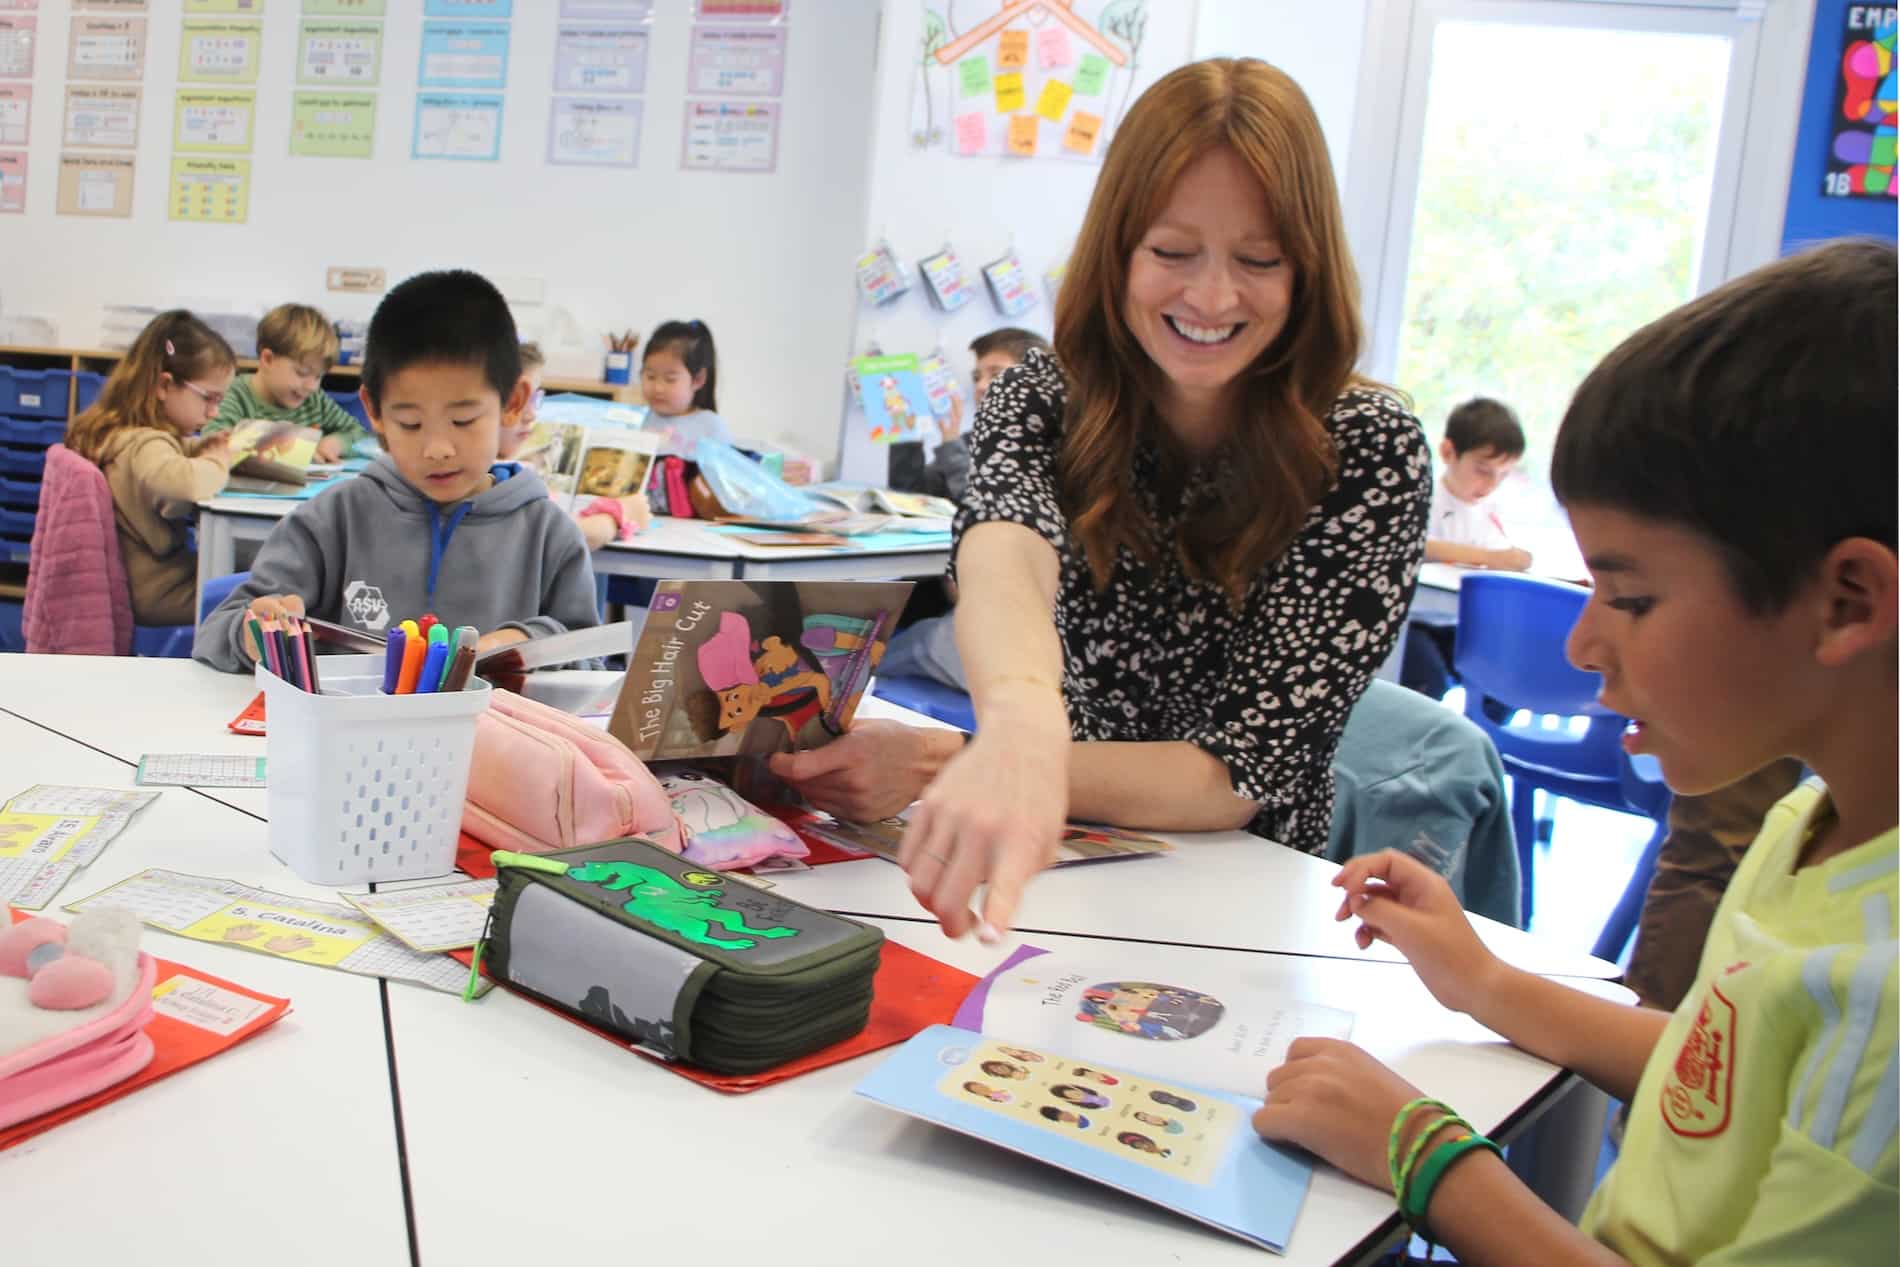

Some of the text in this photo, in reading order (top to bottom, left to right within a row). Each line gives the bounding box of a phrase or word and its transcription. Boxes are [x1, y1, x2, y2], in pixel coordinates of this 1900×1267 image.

[1848, 6, 1897, 30] EMP
[639, 599, 712, 743] The Big Hair Cut
[257, 911, 348, 935] Catalina
